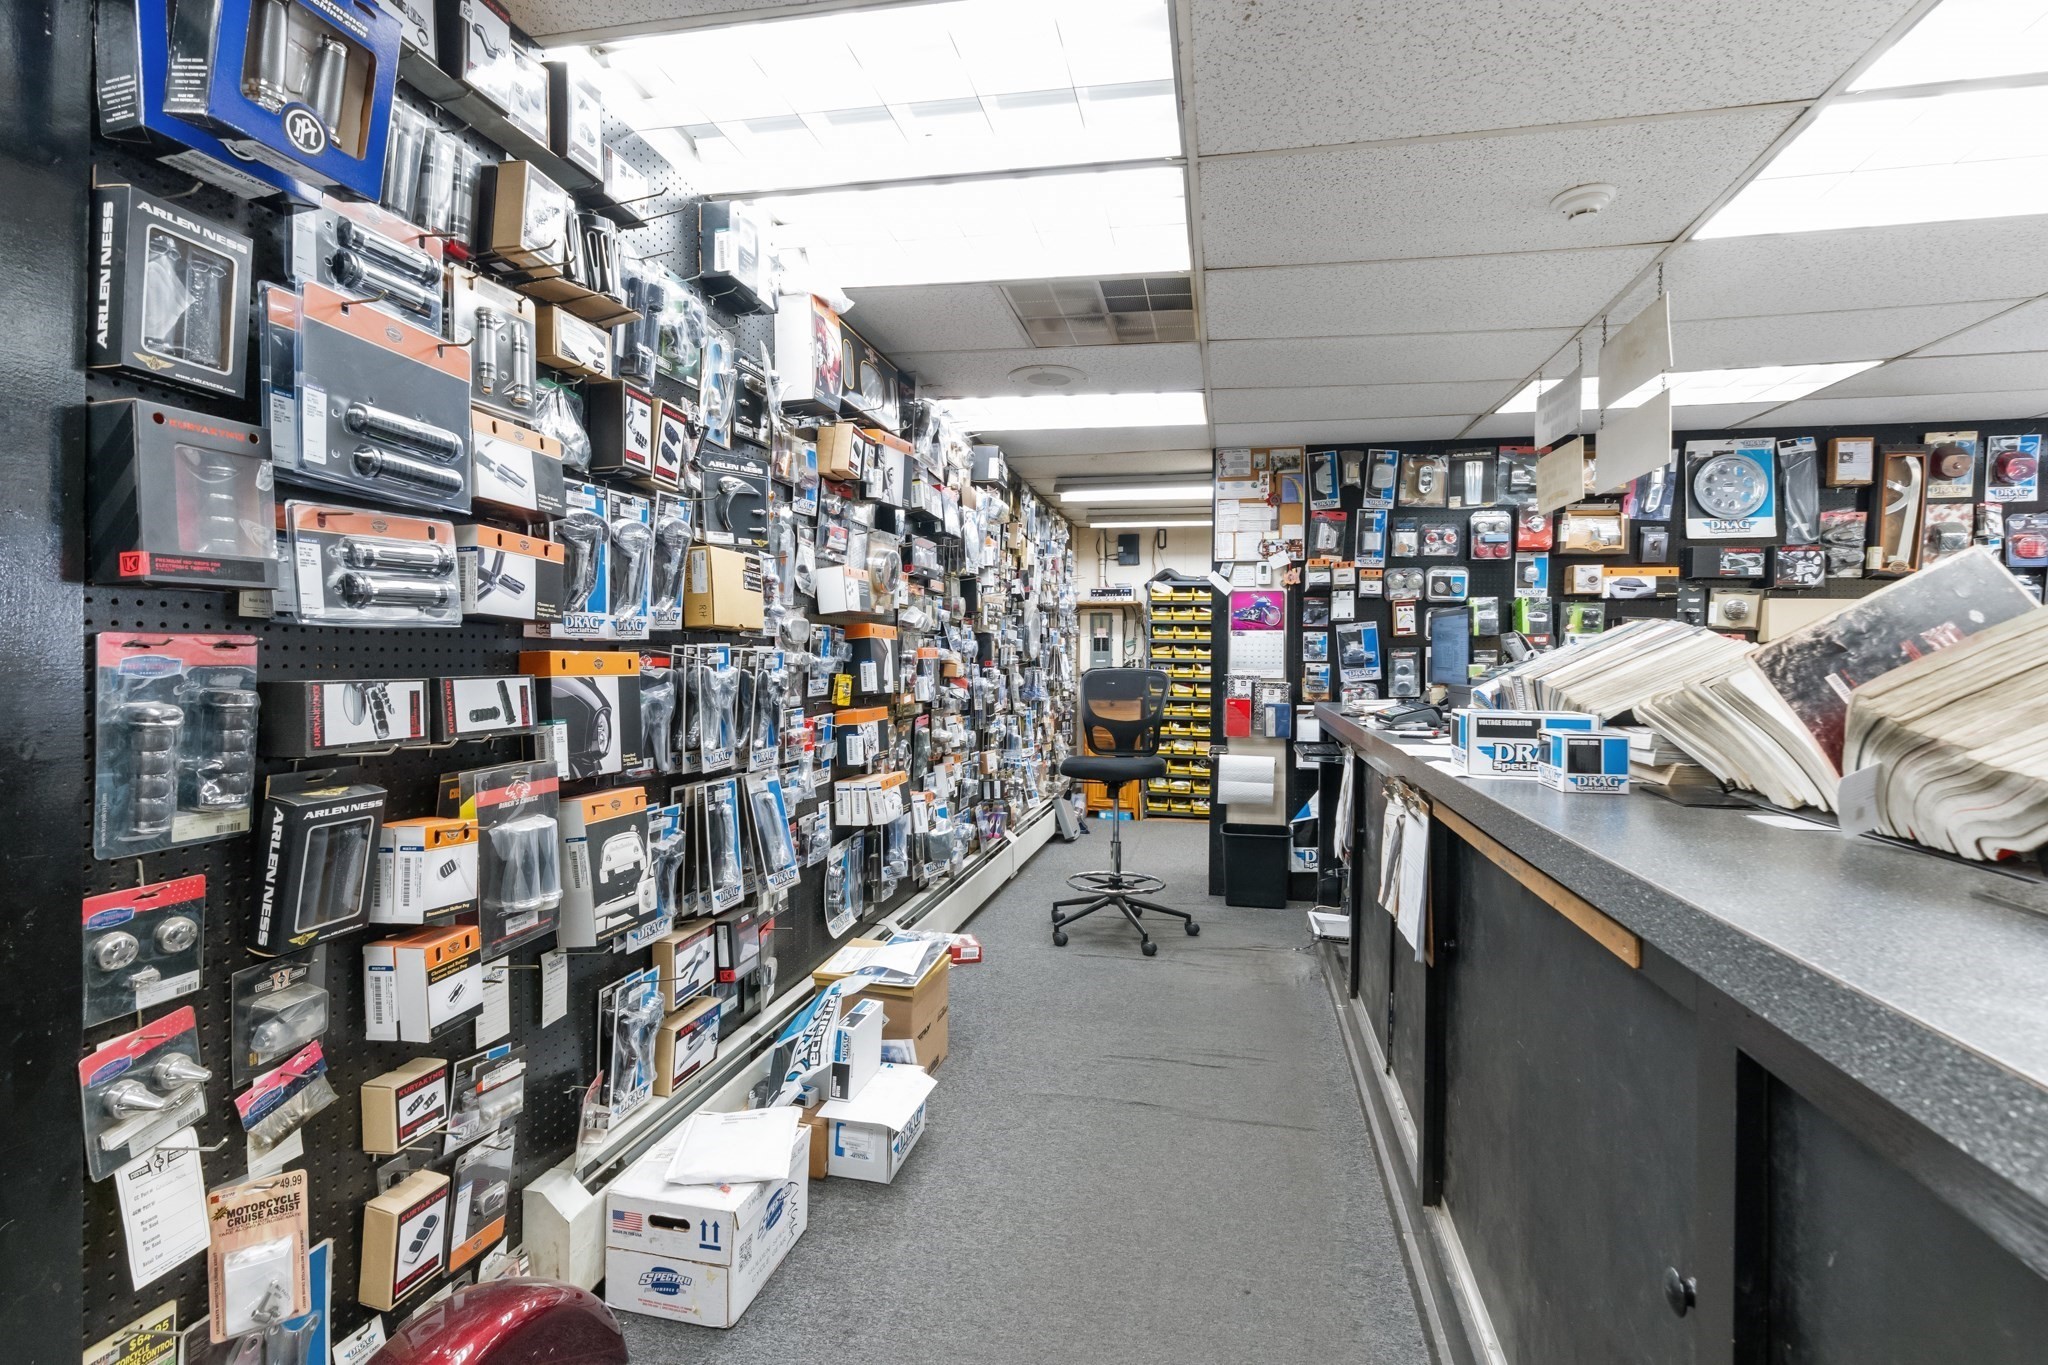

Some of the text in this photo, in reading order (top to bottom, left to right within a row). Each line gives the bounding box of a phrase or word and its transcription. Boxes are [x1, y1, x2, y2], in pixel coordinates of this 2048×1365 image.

[137, 201, 248, 255] ARLEN NESS
[96, 201, 114, 349] ARLEN NESS
[708, 460, 763, 475] ARLEN NESS
[1995, 488, 2028, 497] DRAG
[1710, 519, 1750, 530] DRAG
[565, 614, 599, 628] DRAG
[564, 627, 599, 635] Specialties
[1348, 669, 1373, 677] DRAG
[710, 750, 730, 763] DRAG
[756, 749, 774, 762] DRAG
[1493, 761, 1539, 772] Specia
[1576, 776, 1619, 787] DRAG
[303, 798, 384, 820] ARLEN NESS
[258, 806, 284, 946] ARLEN NESS
[773, 870, 795, 885] DRAG
[719, 885, 740, 903] DRAG
[637, 919, 664, 940] DRAG
[399, 1068, 445, 1097] KURYAKYN
[280, 1174, 302, 1189] 49.99
[226, 1192, 300, 1219] MOTORCYCLE
[401, 1188, 448, 1223] KURYAKYN
[227, 1201, 301, 1228] CRUISE ASSIST
[218, 1230, 233, 1238] TAKE
[638, 1272, 693, 1286] SPECTRO
[141, 1338, 174, 1363] CONTROL
